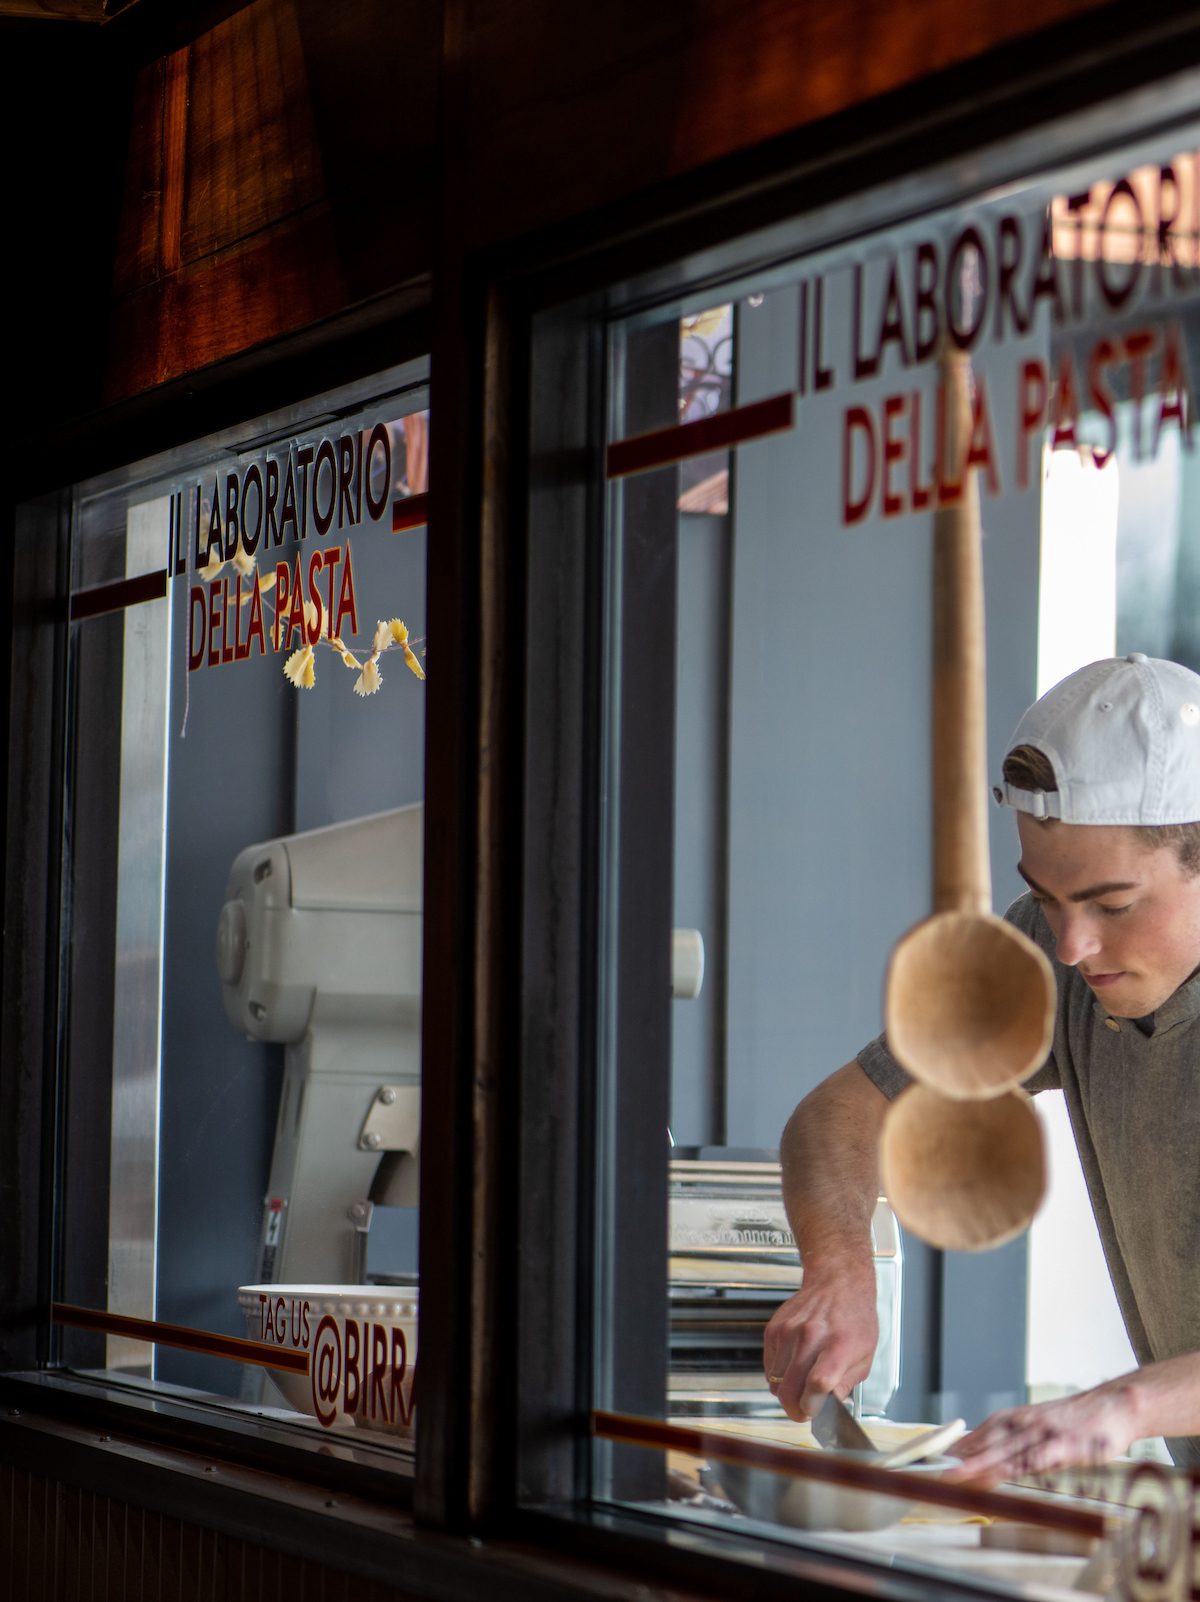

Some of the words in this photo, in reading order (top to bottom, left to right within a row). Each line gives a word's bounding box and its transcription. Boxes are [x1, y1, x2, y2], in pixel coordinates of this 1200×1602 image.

[797, 273, 834, 398] IL
[842, 368, 999, 527] DELLA
[1017, 322, 1196, 491] PASTA
[168, 491, 186, 578] IL
[195, 422, 392, 571] LABORATORIO
[188, 562, 266, 672] DELLA
[273, 537, 359, 653] PASTA
[259, 1294, 286, 1344] TAG
[291, 1299, 310, 1348] US
